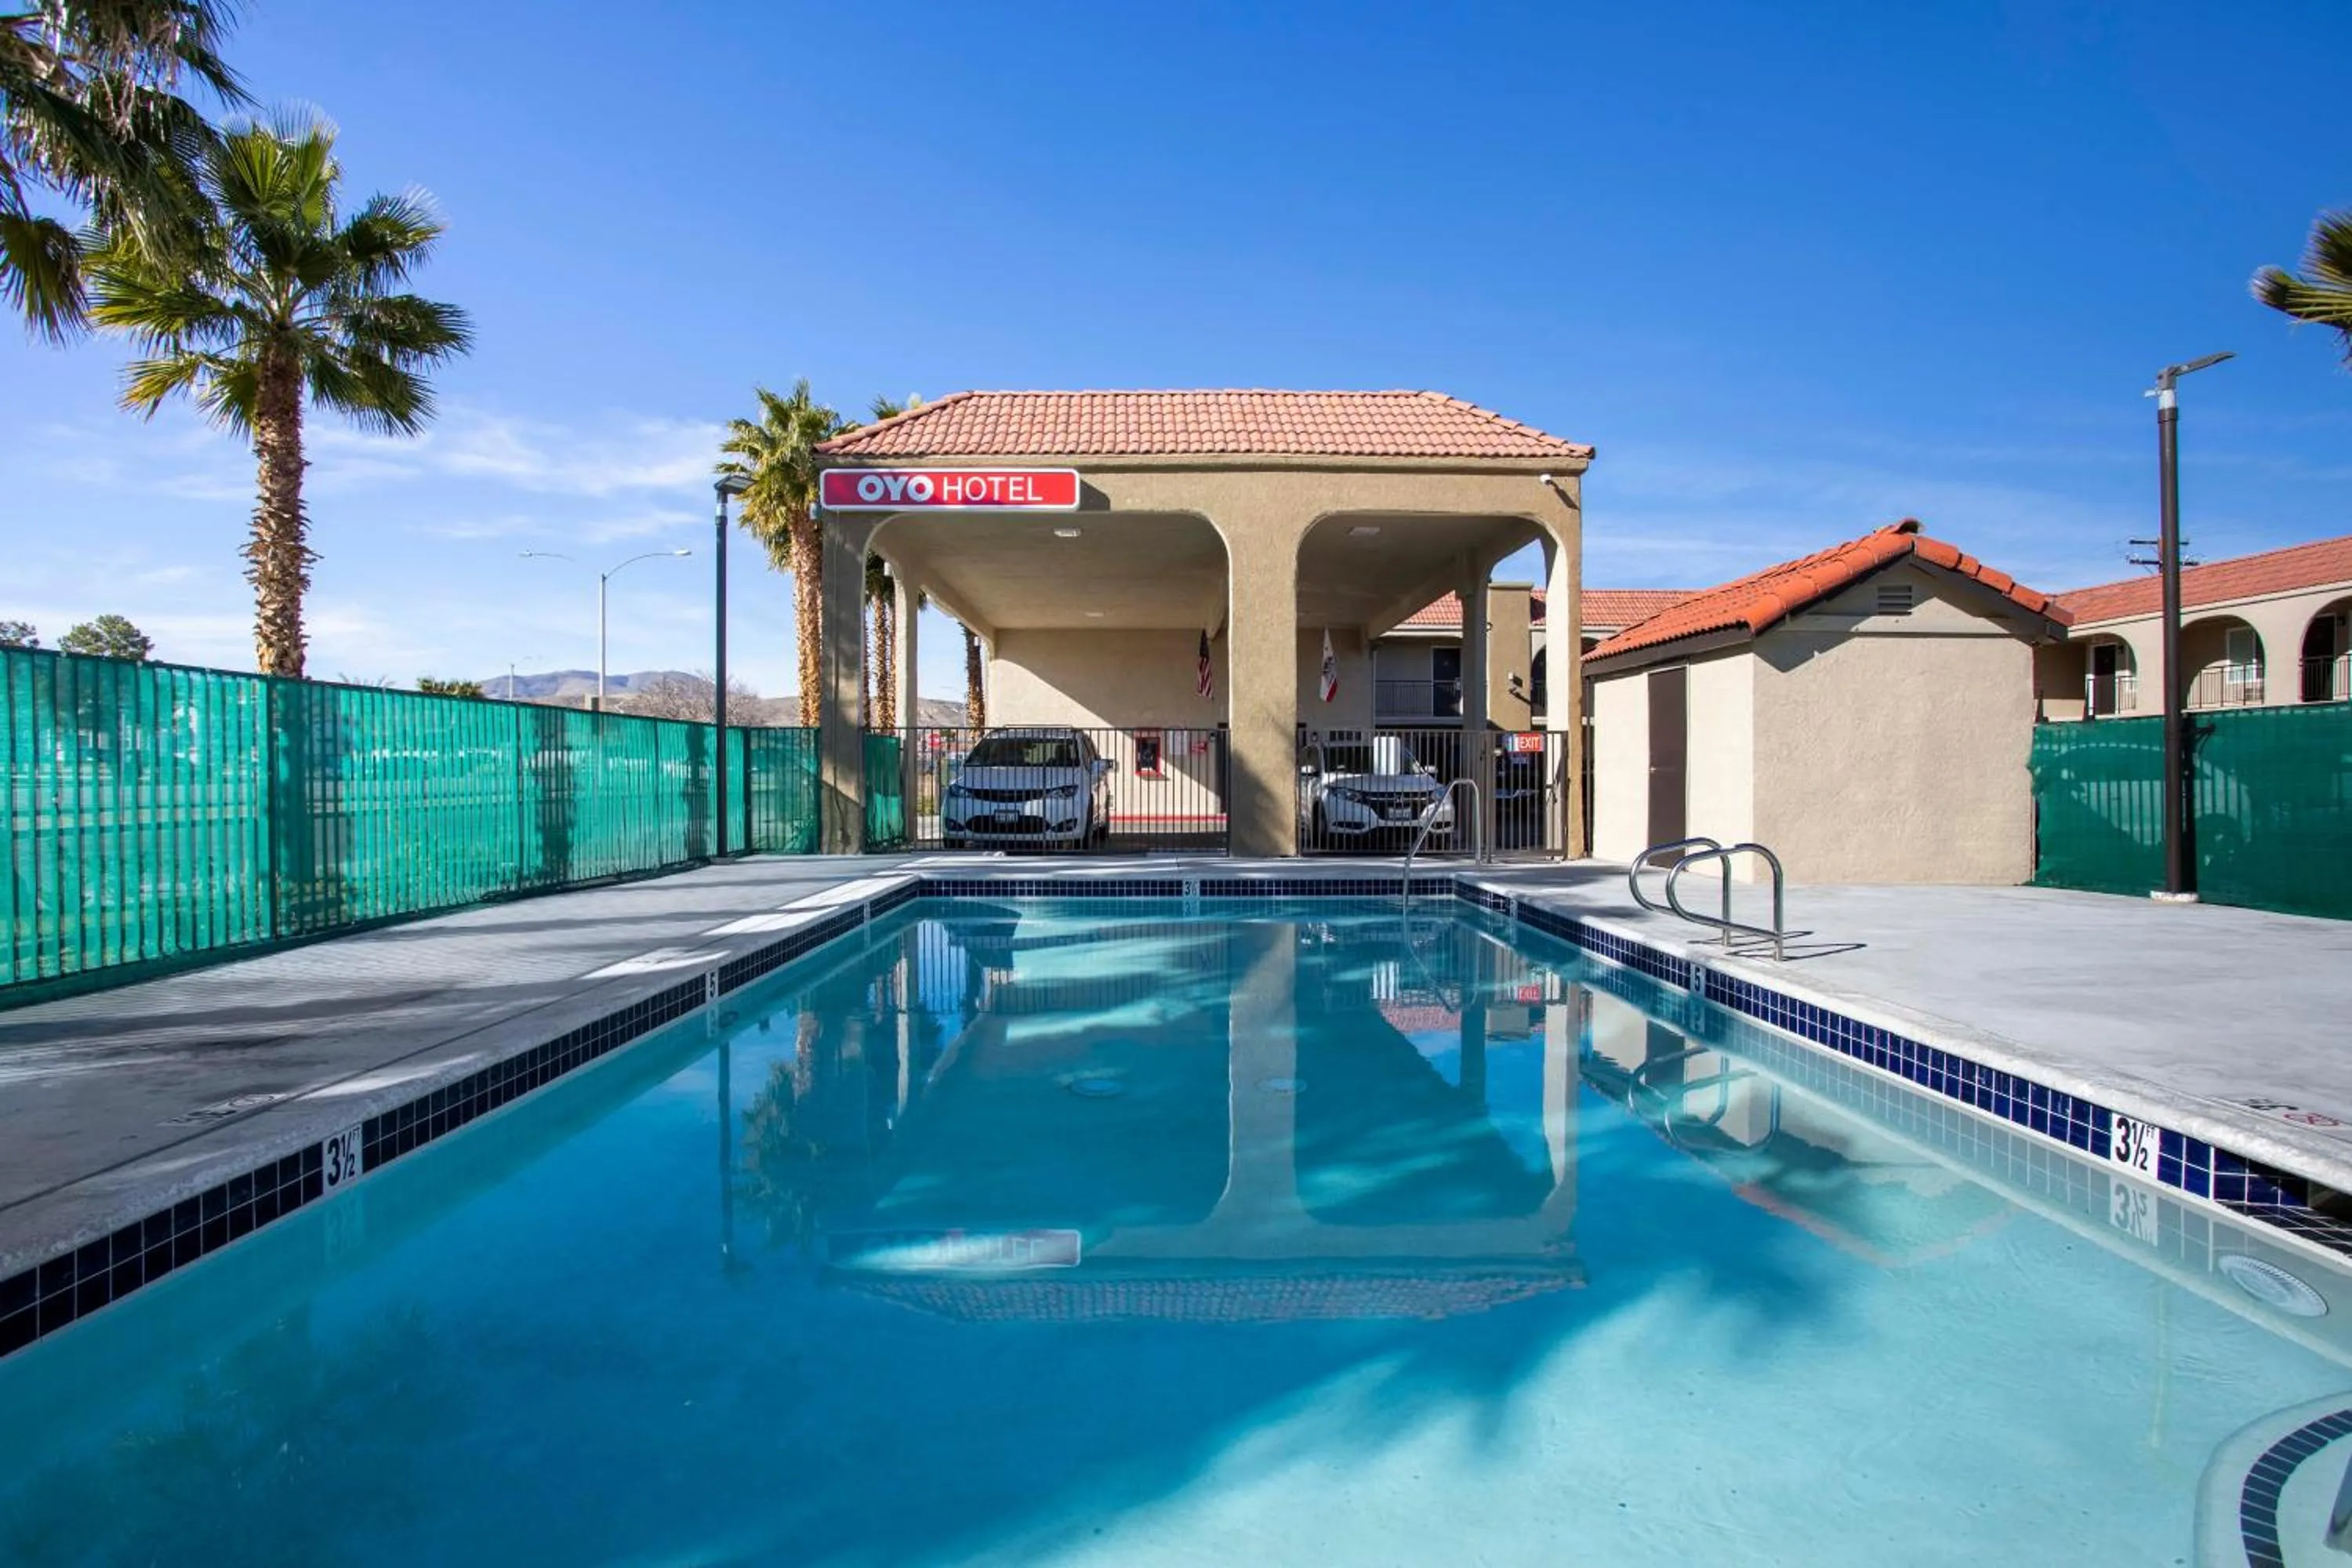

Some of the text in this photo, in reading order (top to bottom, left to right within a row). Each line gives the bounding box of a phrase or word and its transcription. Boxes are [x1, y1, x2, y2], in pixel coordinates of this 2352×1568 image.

[857, 474, 1043, 502] OYO HOTEL
[1520, 736, 1539, 749] EXIT
